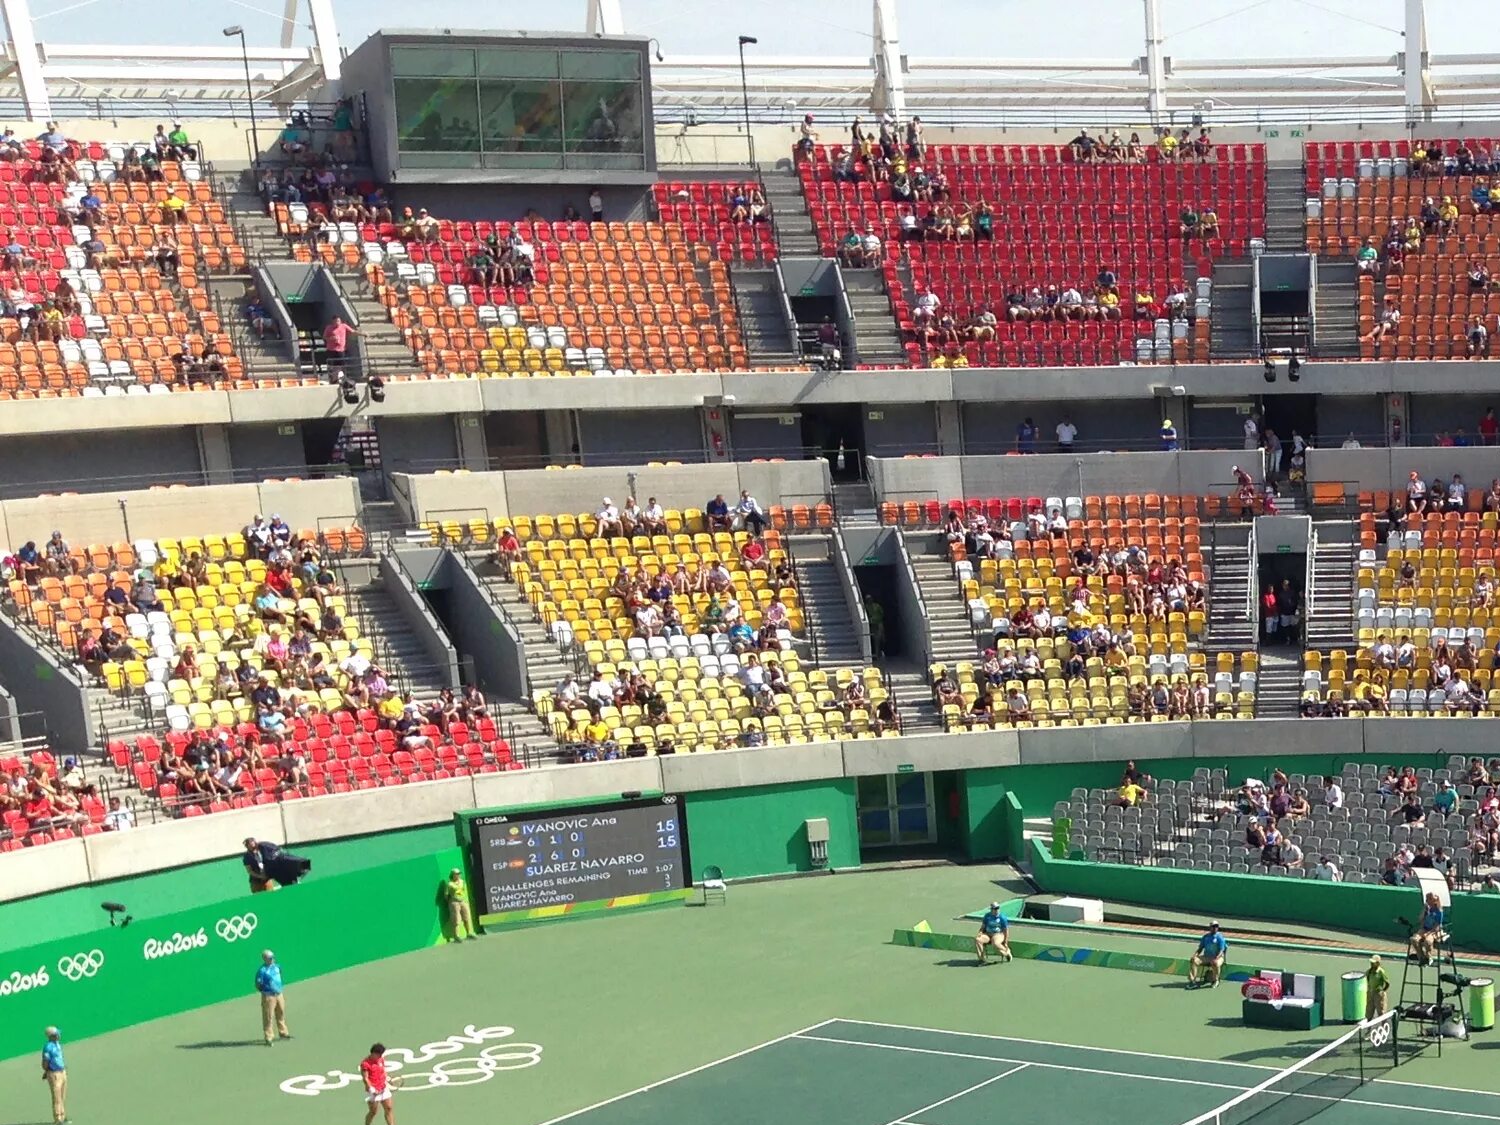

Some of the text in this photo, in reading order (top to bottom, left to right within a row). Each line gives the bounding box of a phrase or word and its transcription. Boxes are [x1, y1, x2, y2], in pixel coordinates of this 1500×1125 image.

[484, 816, 508, 824] OMEGA
[522, 817, 617, 834] IVANOVIC Ana
[656, 820, 674, 833] 15
[489, 832, 578, 847] SRB 6 1 0
[657, 835, 676, 848] 15
[492, 848, 580, 871] ESP 2 6 0
[526, 853, 645, 877] SUAREZ NAVARRO
[627, 863, 673, 876] TIME 1:07
[490, 872, 611, 894] CHALLENGES REMAINING
[491, 889, 557, 903] IVANOVIC Ana
[491, 893, 574, 911] SUAREZ NAVARRO
[143, 927, 208, 960] Rio2016
[0, 965, 50, 996] o2016
